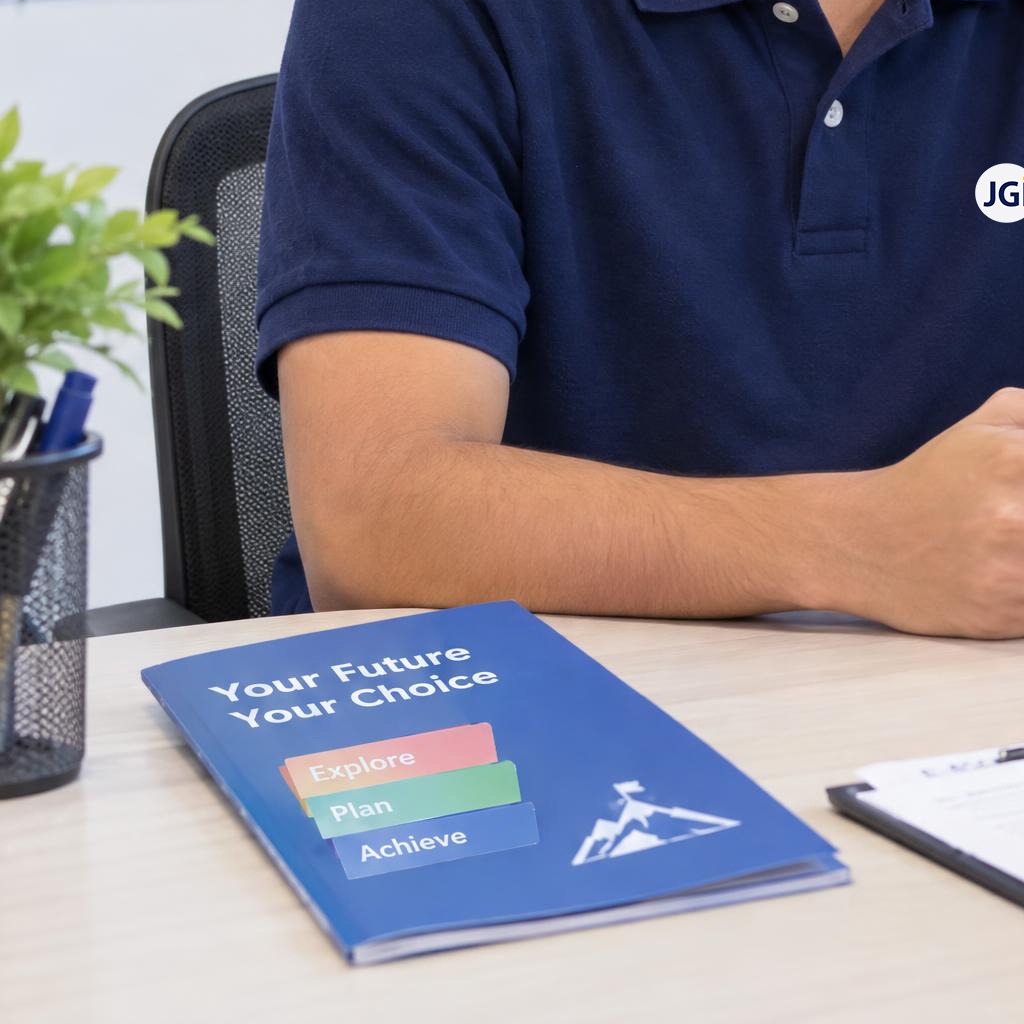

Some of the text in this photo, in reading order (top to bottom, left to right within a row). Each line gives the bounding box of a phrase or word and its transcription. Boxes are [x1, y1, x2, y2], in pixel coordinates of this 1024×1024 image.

[208, 647, 472, 703] Your Future
[228, 671, 499, 729] Your Choice
[309, 752, 417, 782] Explore
[329, 800, 394, 823] Plan
[360, 831, 468, 862] Achieve
